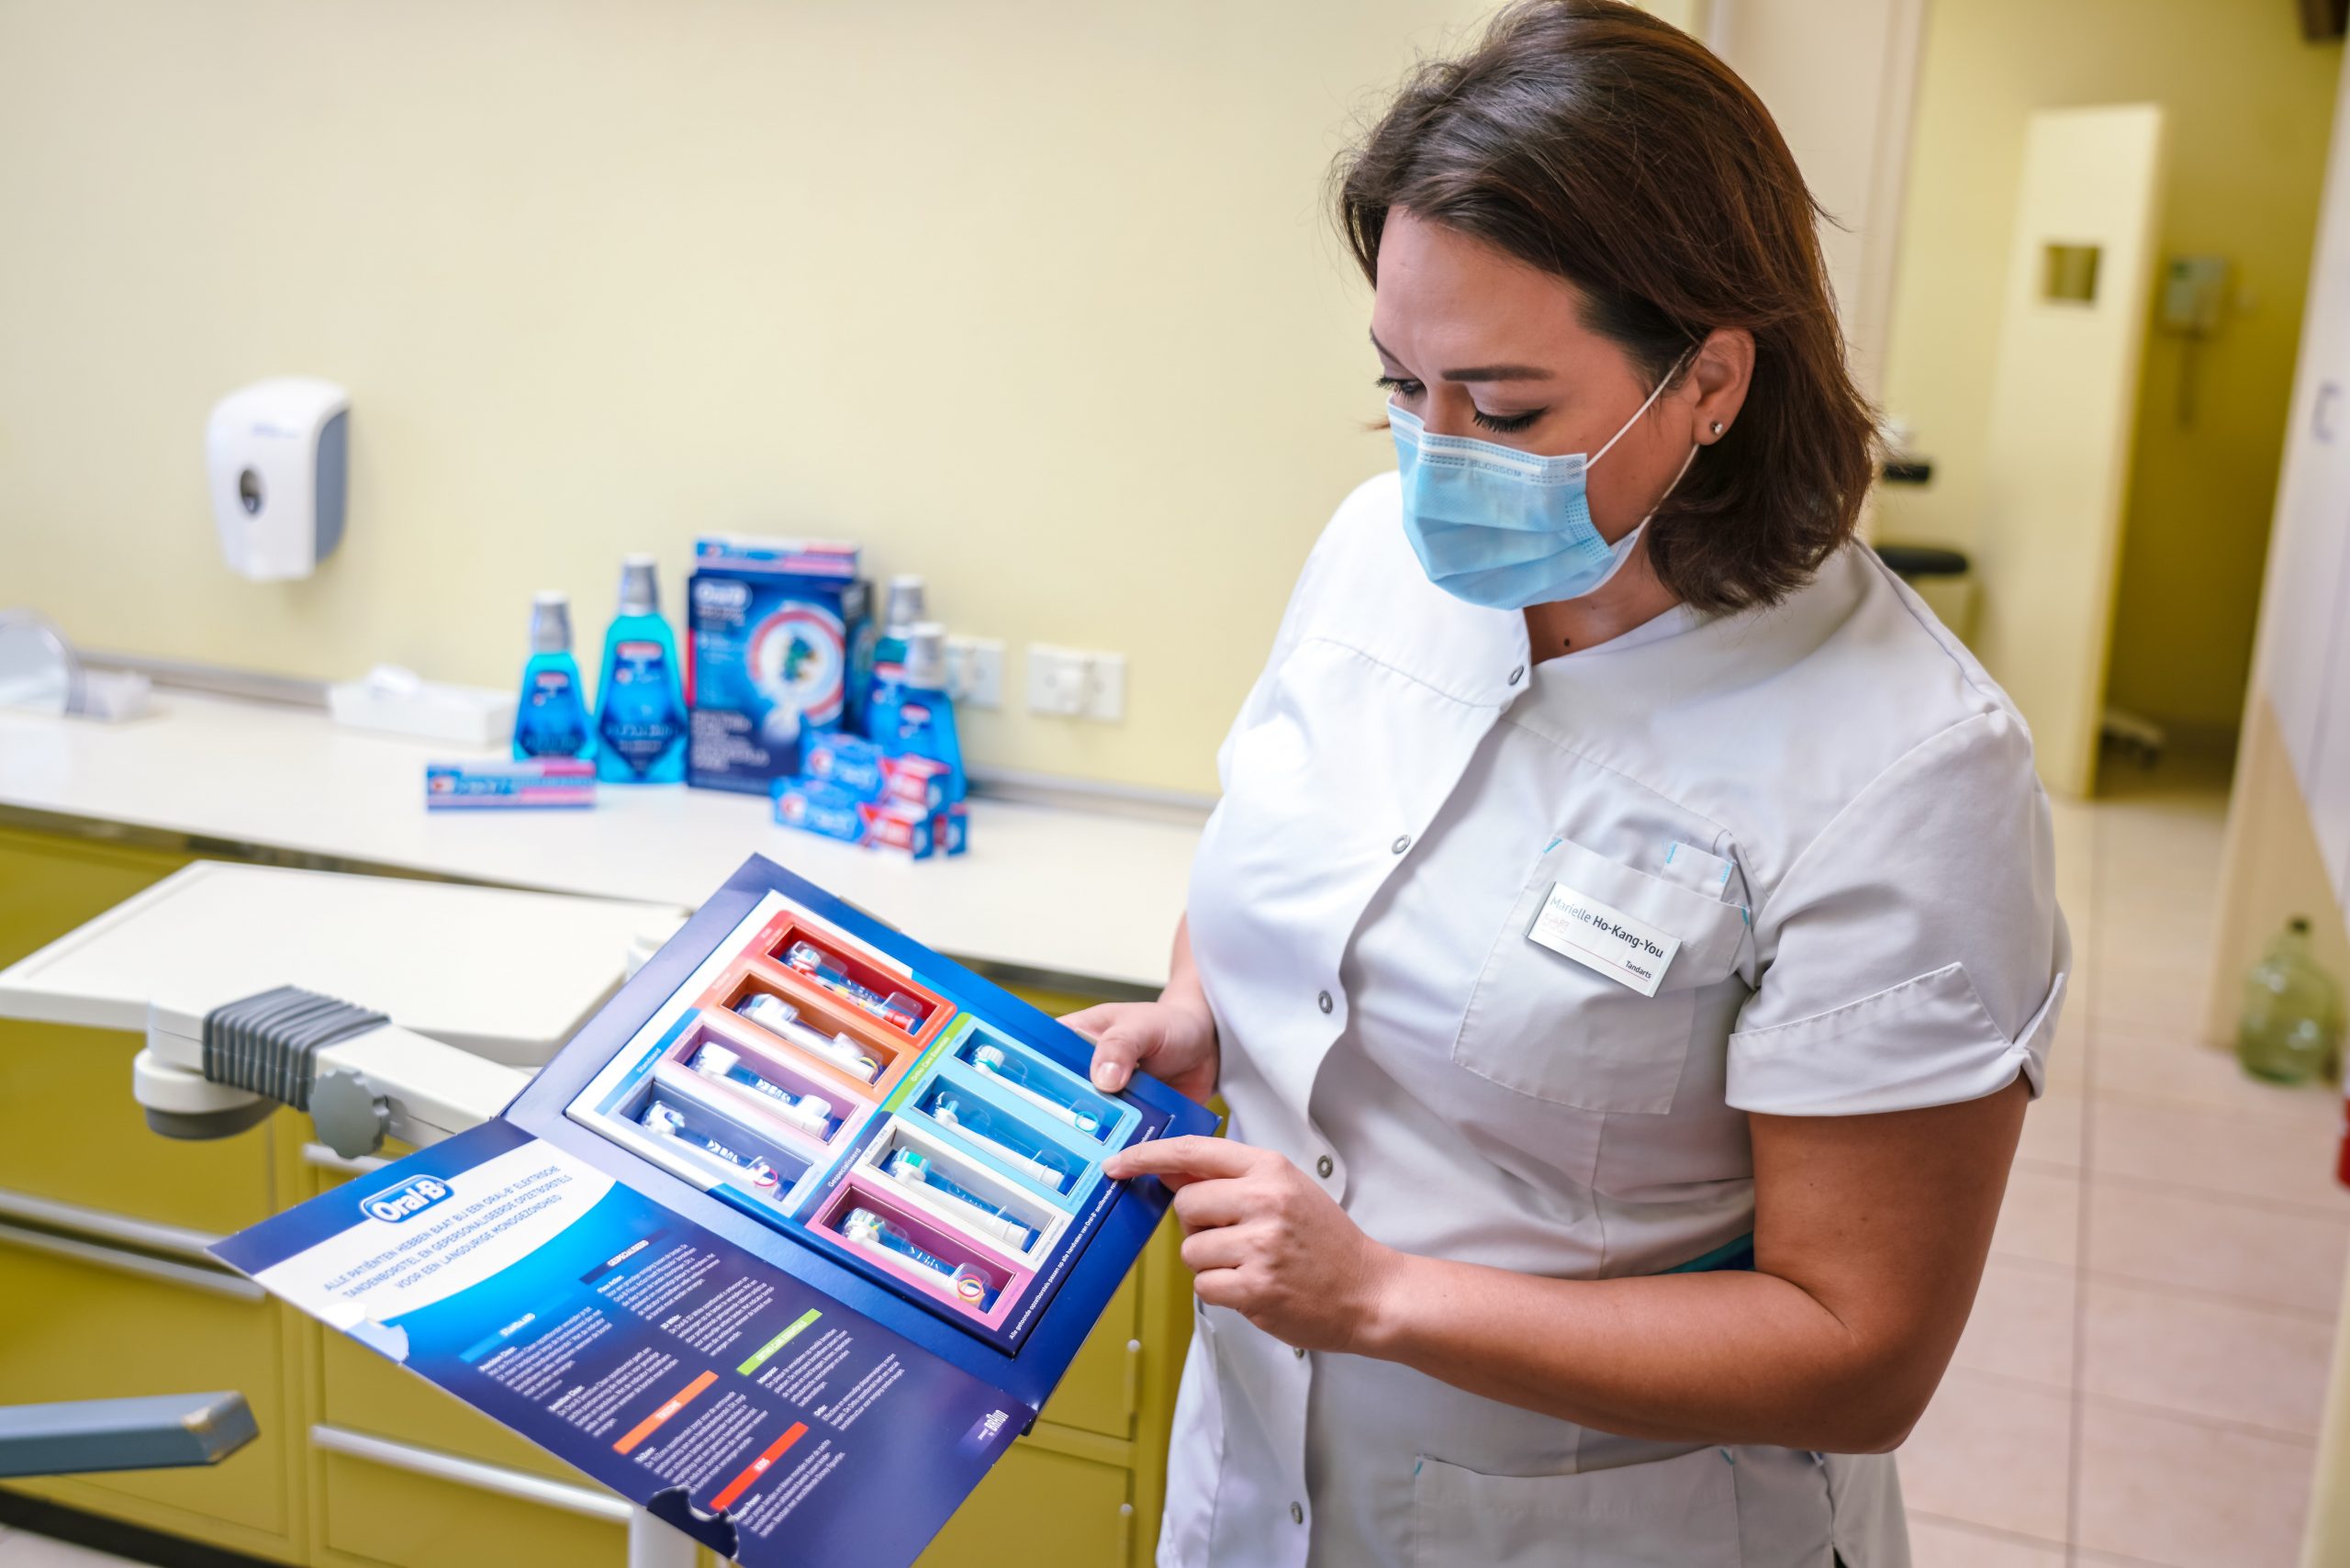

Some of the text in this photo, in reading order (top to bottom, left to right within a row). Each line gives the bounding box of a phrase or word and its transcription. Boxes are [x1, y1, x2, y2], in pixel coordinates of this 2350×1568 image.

[1550, 896, 1592, 924] Marielle
[1593, 915, 1664, 958] Ho-Kang-You
[1625, 960, 1652, 980] Tandarts
[635, 1047, 662, 1073] Standaard
[826, 1147, 862, 1188] Gespecialiseerd
[372, 1181, 446, 1222] Oral-B
[319, 1273, 352, 1291] ALLE
[343, 1249, 398, 1278] PATIËNTEN
[393, 1230, 432, 1252] HEBBEN
[428, 1218, 456, 1233] BAAT
[450, 1211, 469, 1221] BIJ
[464, 1202, 486, 1214] EEN
[510, 1164, 561, 1189] ELEKTRISCHE
[341, 1174, 574, 1298] TANDENBORSTEL EN GEPERSONALISEERDE OPZETBORSTELS
[393, 1193, 564, 1289] VOOR EEN LANGDURIGE MONDGEZONDHEID
[1008, 1328, 1018, 1339] Alle
[1014, 1308, 1032, 1330] getoonde
[1028, 1281, 1051, 1310] opzetborstels
[1046, 1267, 1060, 1282] passen
[1061, 1253, 1070, 1262] alle
[1066, 1232, 1084, 1254] handvaten
[1080, 1225, 1090, 1234] van
[984, 1408, 1009, 1435] BRAUN
